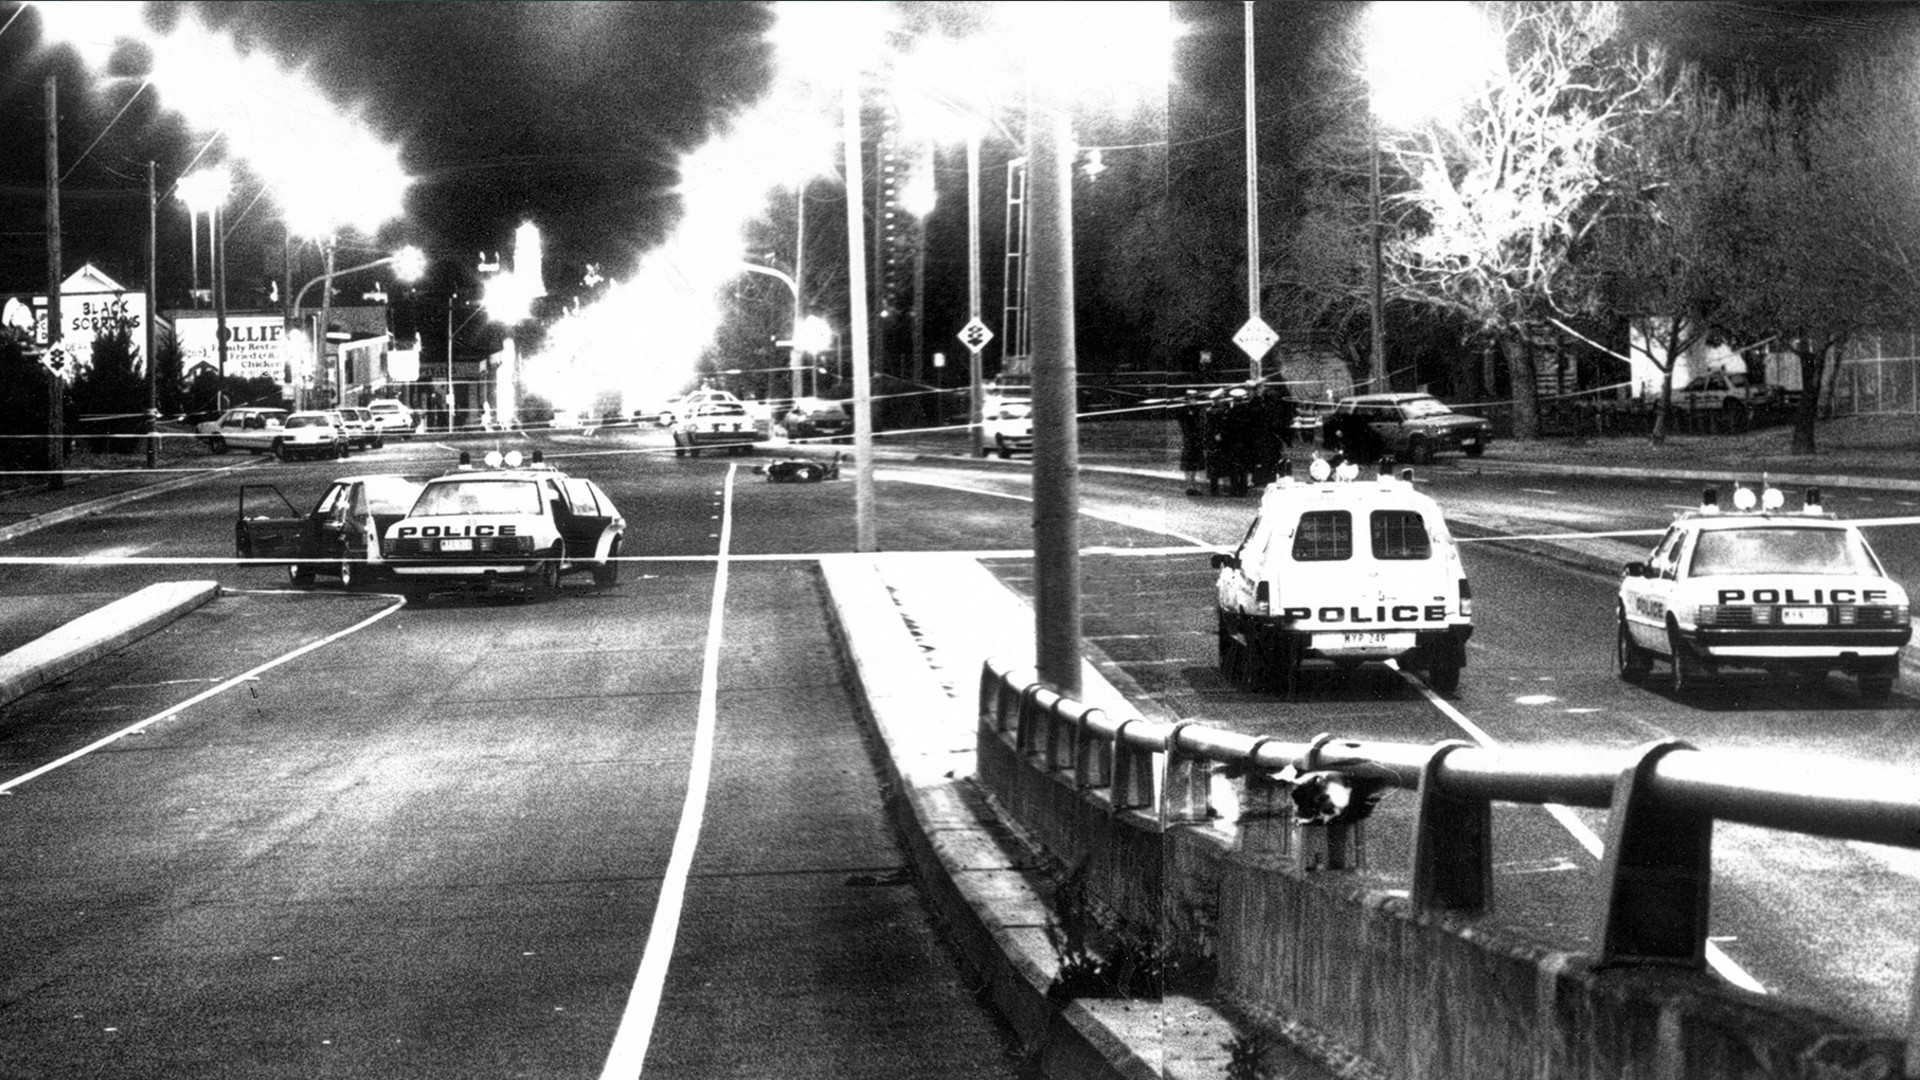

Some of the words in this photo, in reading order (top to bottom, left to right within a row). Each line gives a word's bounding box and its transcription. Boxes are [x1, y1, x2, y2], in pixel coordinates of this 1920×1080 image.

[83, 300, 129, 316] BLACK
[398, 525, 516, 538] POLICE
[1718, 589, 1887, 605] POLICE
[1284, 605, 1446, 622] POLICE
[1345, 633, 1364, 643] MYP
[1369, 633, 1386, 643] 249
